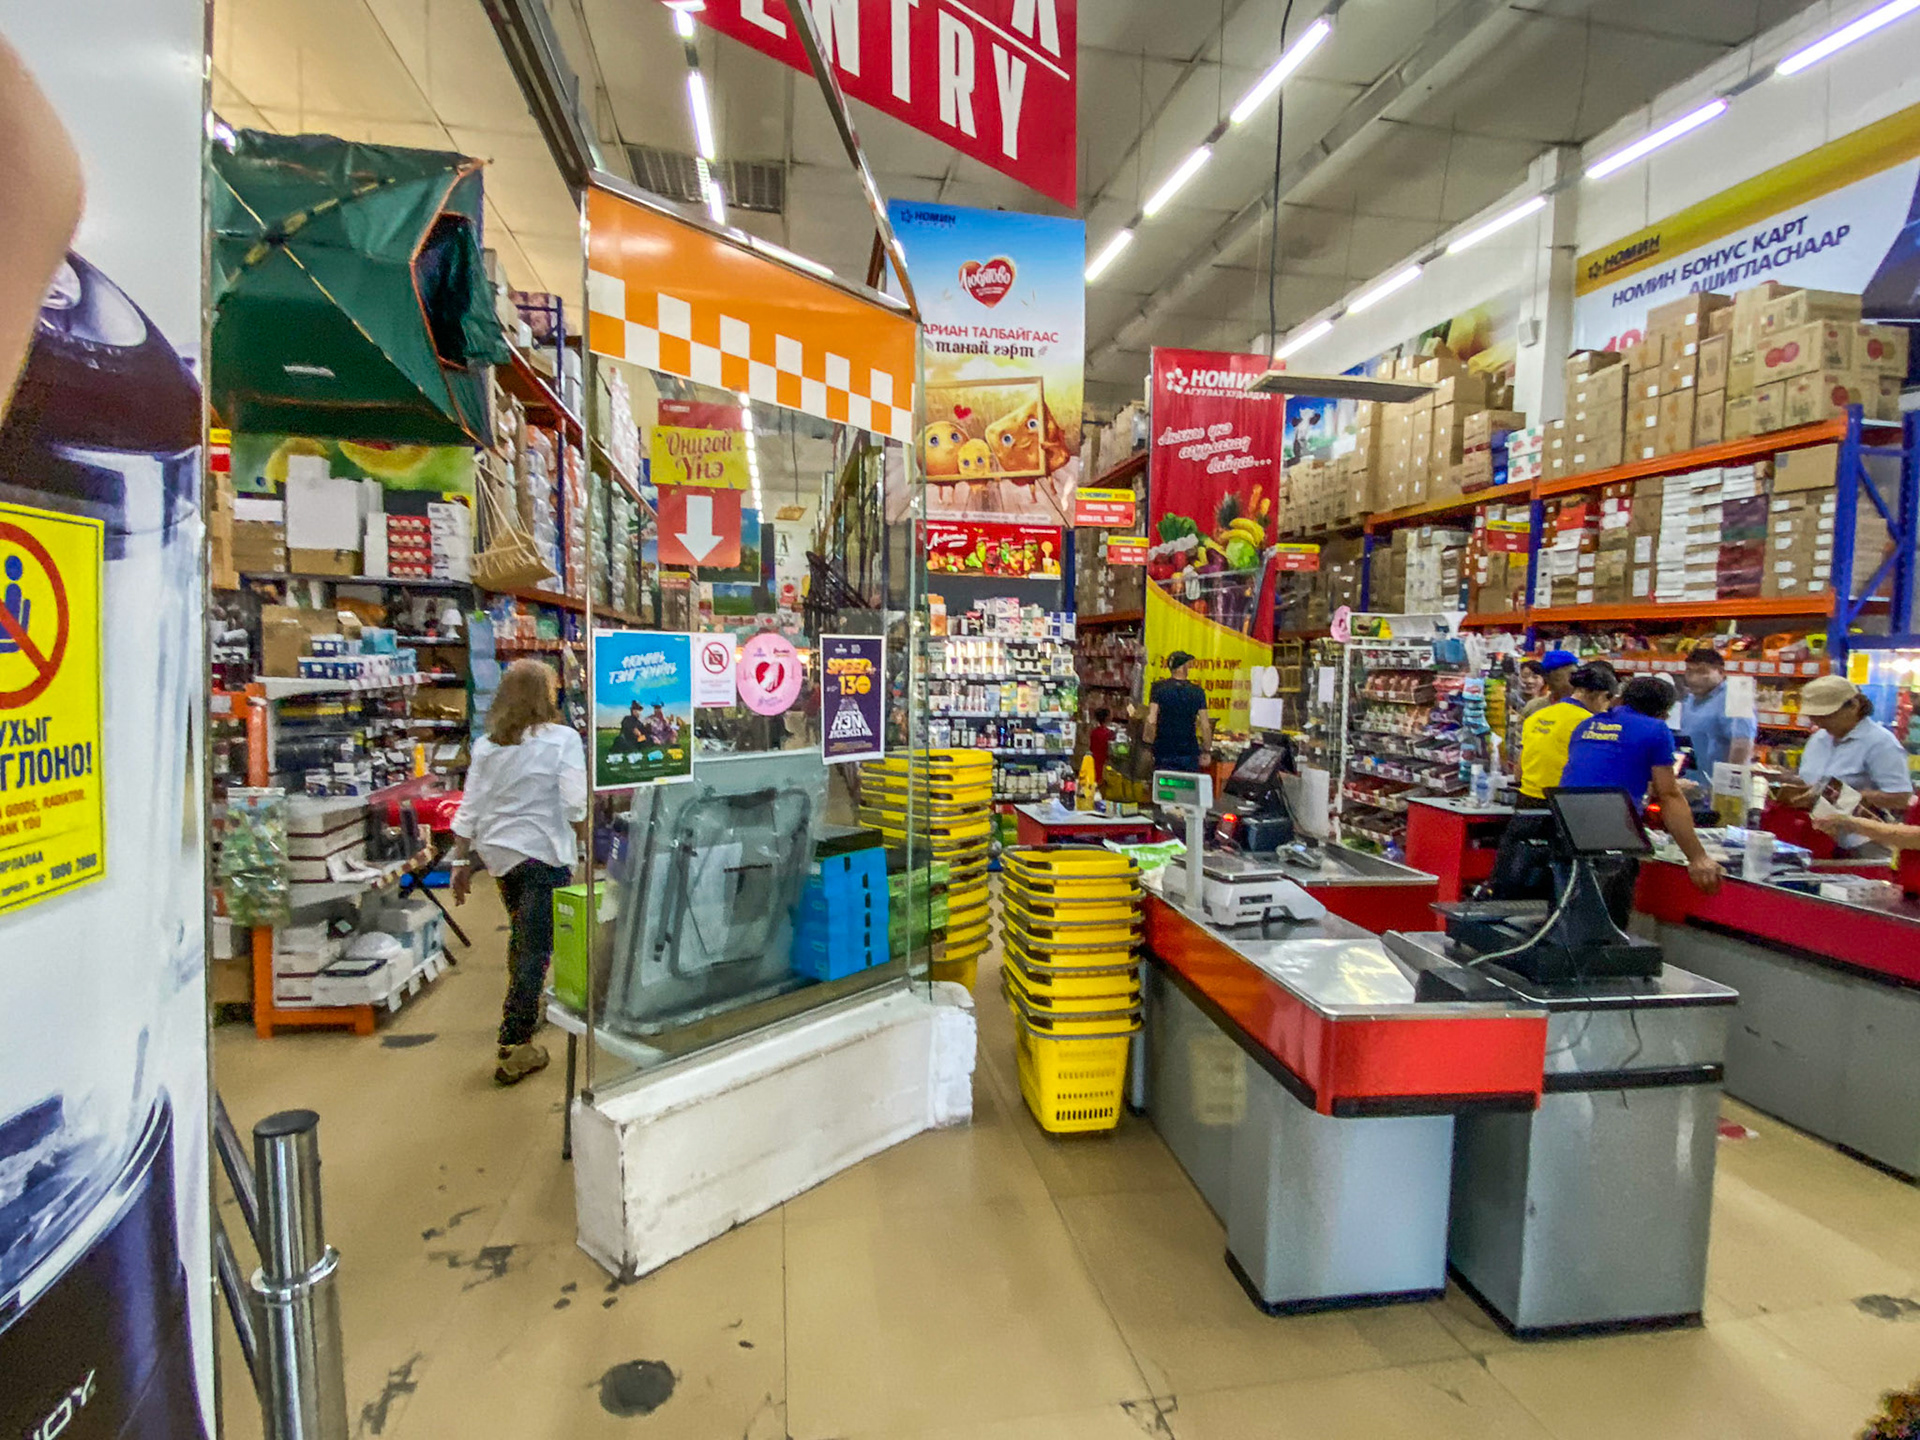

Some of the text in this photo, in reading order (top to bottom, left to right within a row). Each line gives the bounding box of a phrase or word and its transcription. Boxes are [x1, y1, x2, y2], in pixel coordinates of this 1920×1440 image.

[740, 0, 1028, 161] NTRY
[914, 212, 956, 225] НОМИН
[1603, 234, 1660, 269] НОМИН
[1612, 216, 1809, 308] НОМИН БОНУС КАРТ
[1688, 224, 1851, 295] АШИГЛАСНААР
[935, 340, 1035, 360] танай гэрт
[972, 326, 1060, 343] ТАЛБАЙГААС
